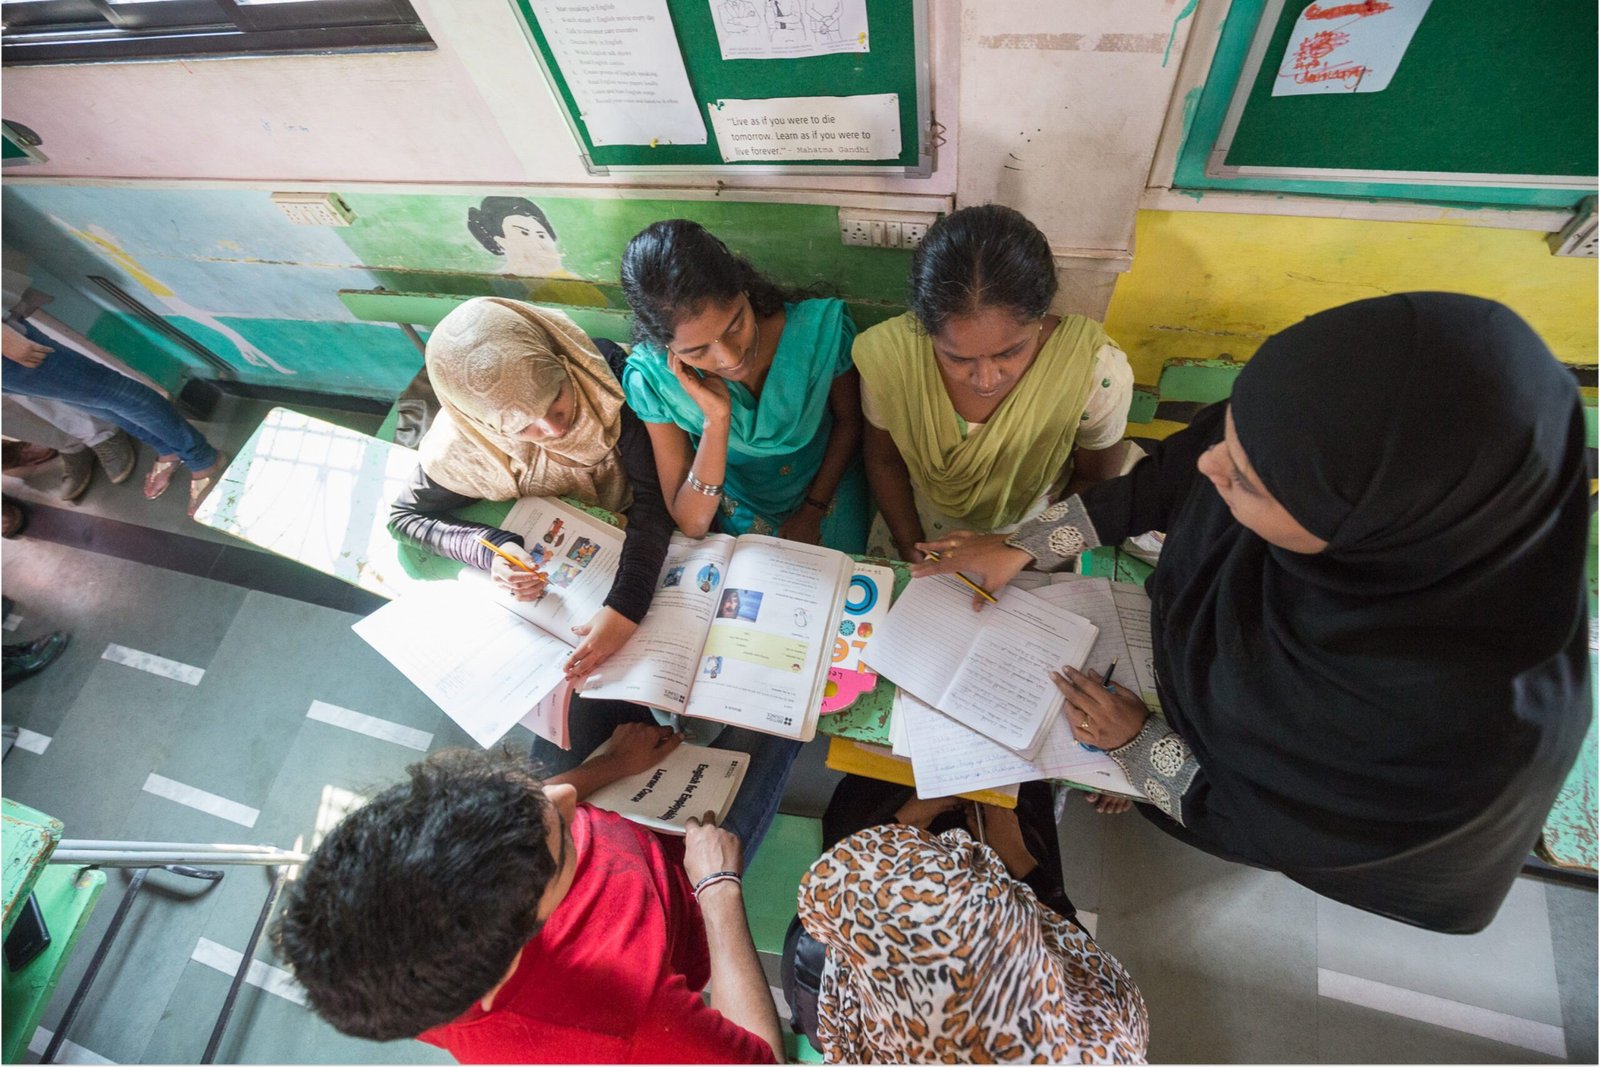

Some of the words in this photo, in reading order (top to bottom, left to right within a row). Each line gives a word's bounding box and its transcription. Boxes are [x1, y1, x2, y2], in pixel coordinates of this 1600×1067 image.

[762, 116, 768, 125] if
[769, 118, 785, 130] you
[822, 115, 835, 124] die
[731, 132, 774, 141] tomorrow.
[775, 132, 798, 140] Learn
[812, 131, 818, 140] if
[820, 132, 836, 144] you
[862, 130, 870, 139] to
[735, 146, 749, 156] live
[646, 768, 667, 789] Learner
[690, 763, 708, 784] English
[685, 784, 697, 793] for
